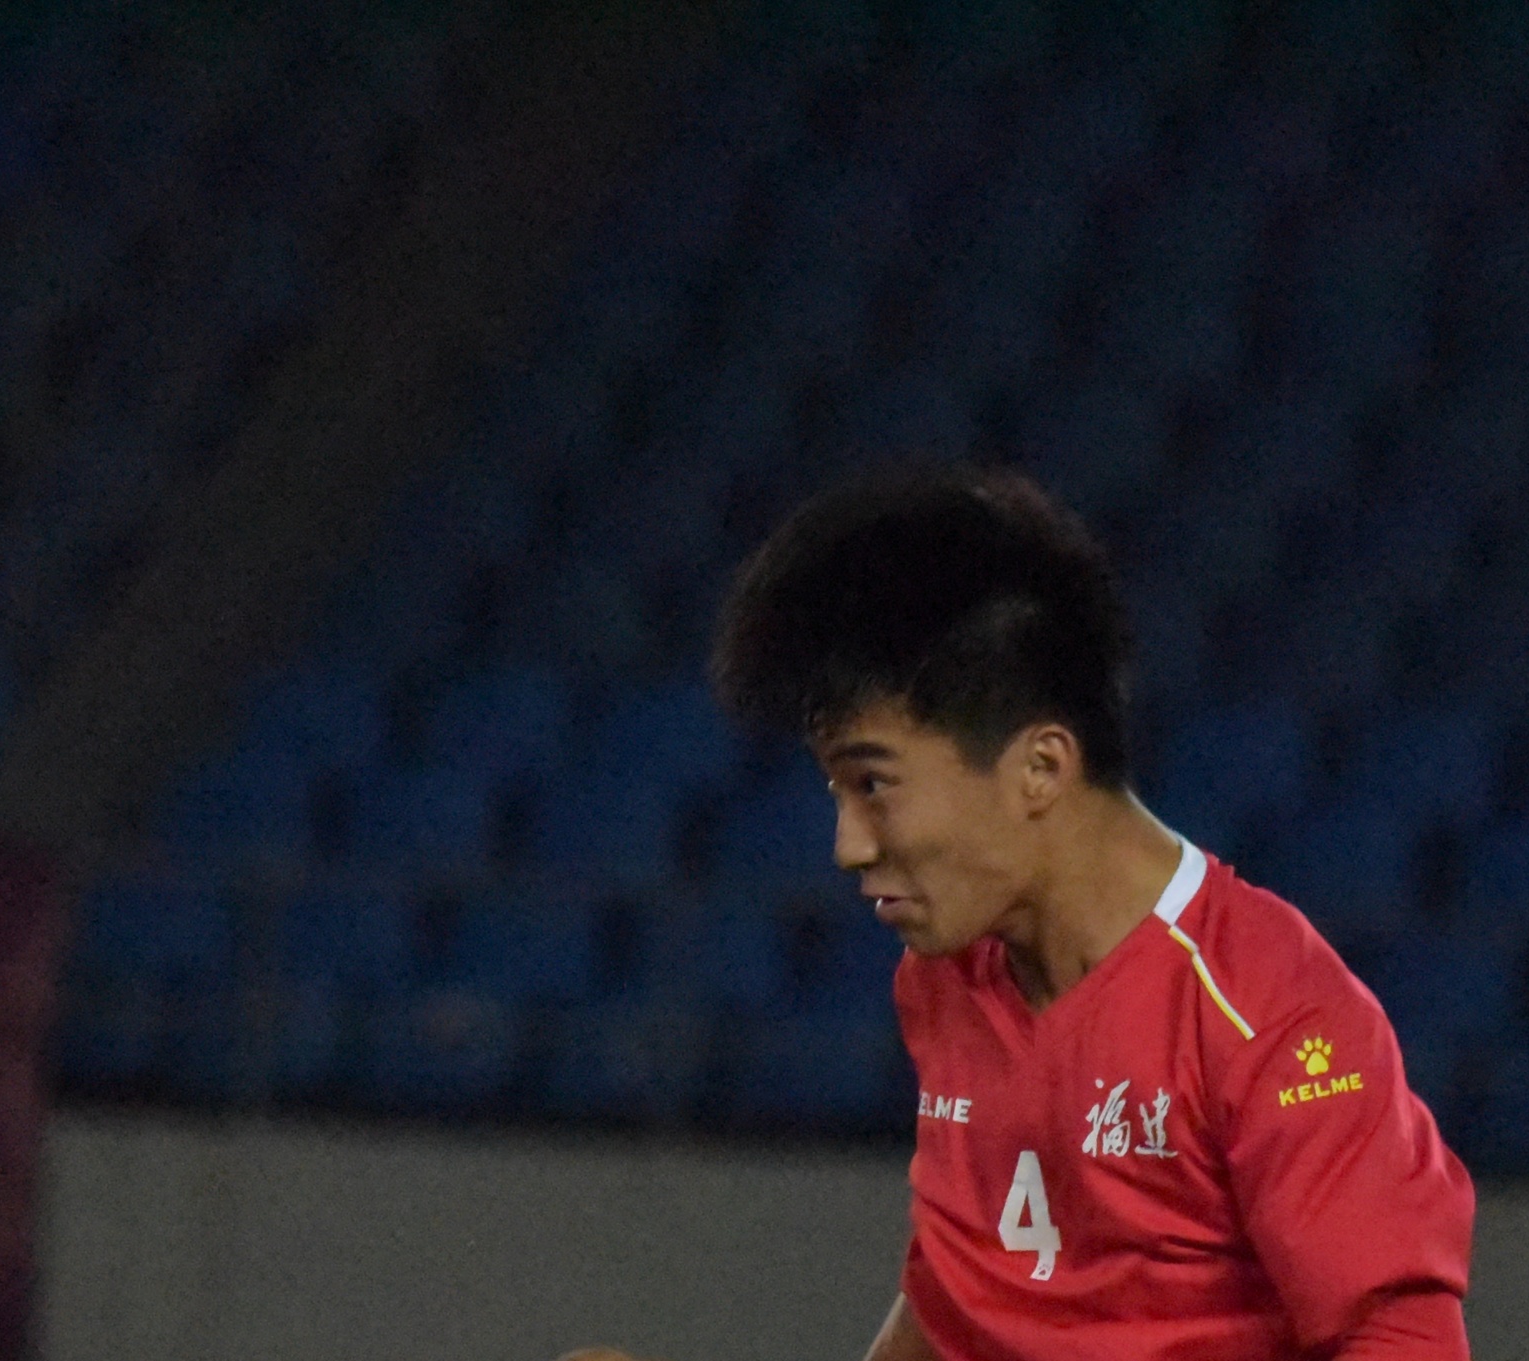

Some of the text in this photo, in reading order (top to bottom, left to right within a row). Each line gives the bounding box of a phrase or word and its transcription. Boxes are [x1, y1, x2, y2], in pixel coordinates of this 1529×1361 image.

[1082, 1079, 1178, 1158] 福建
[1278, 1072, 1364, 1108] KELME
[998, 1150, 1062, 1281] 4
